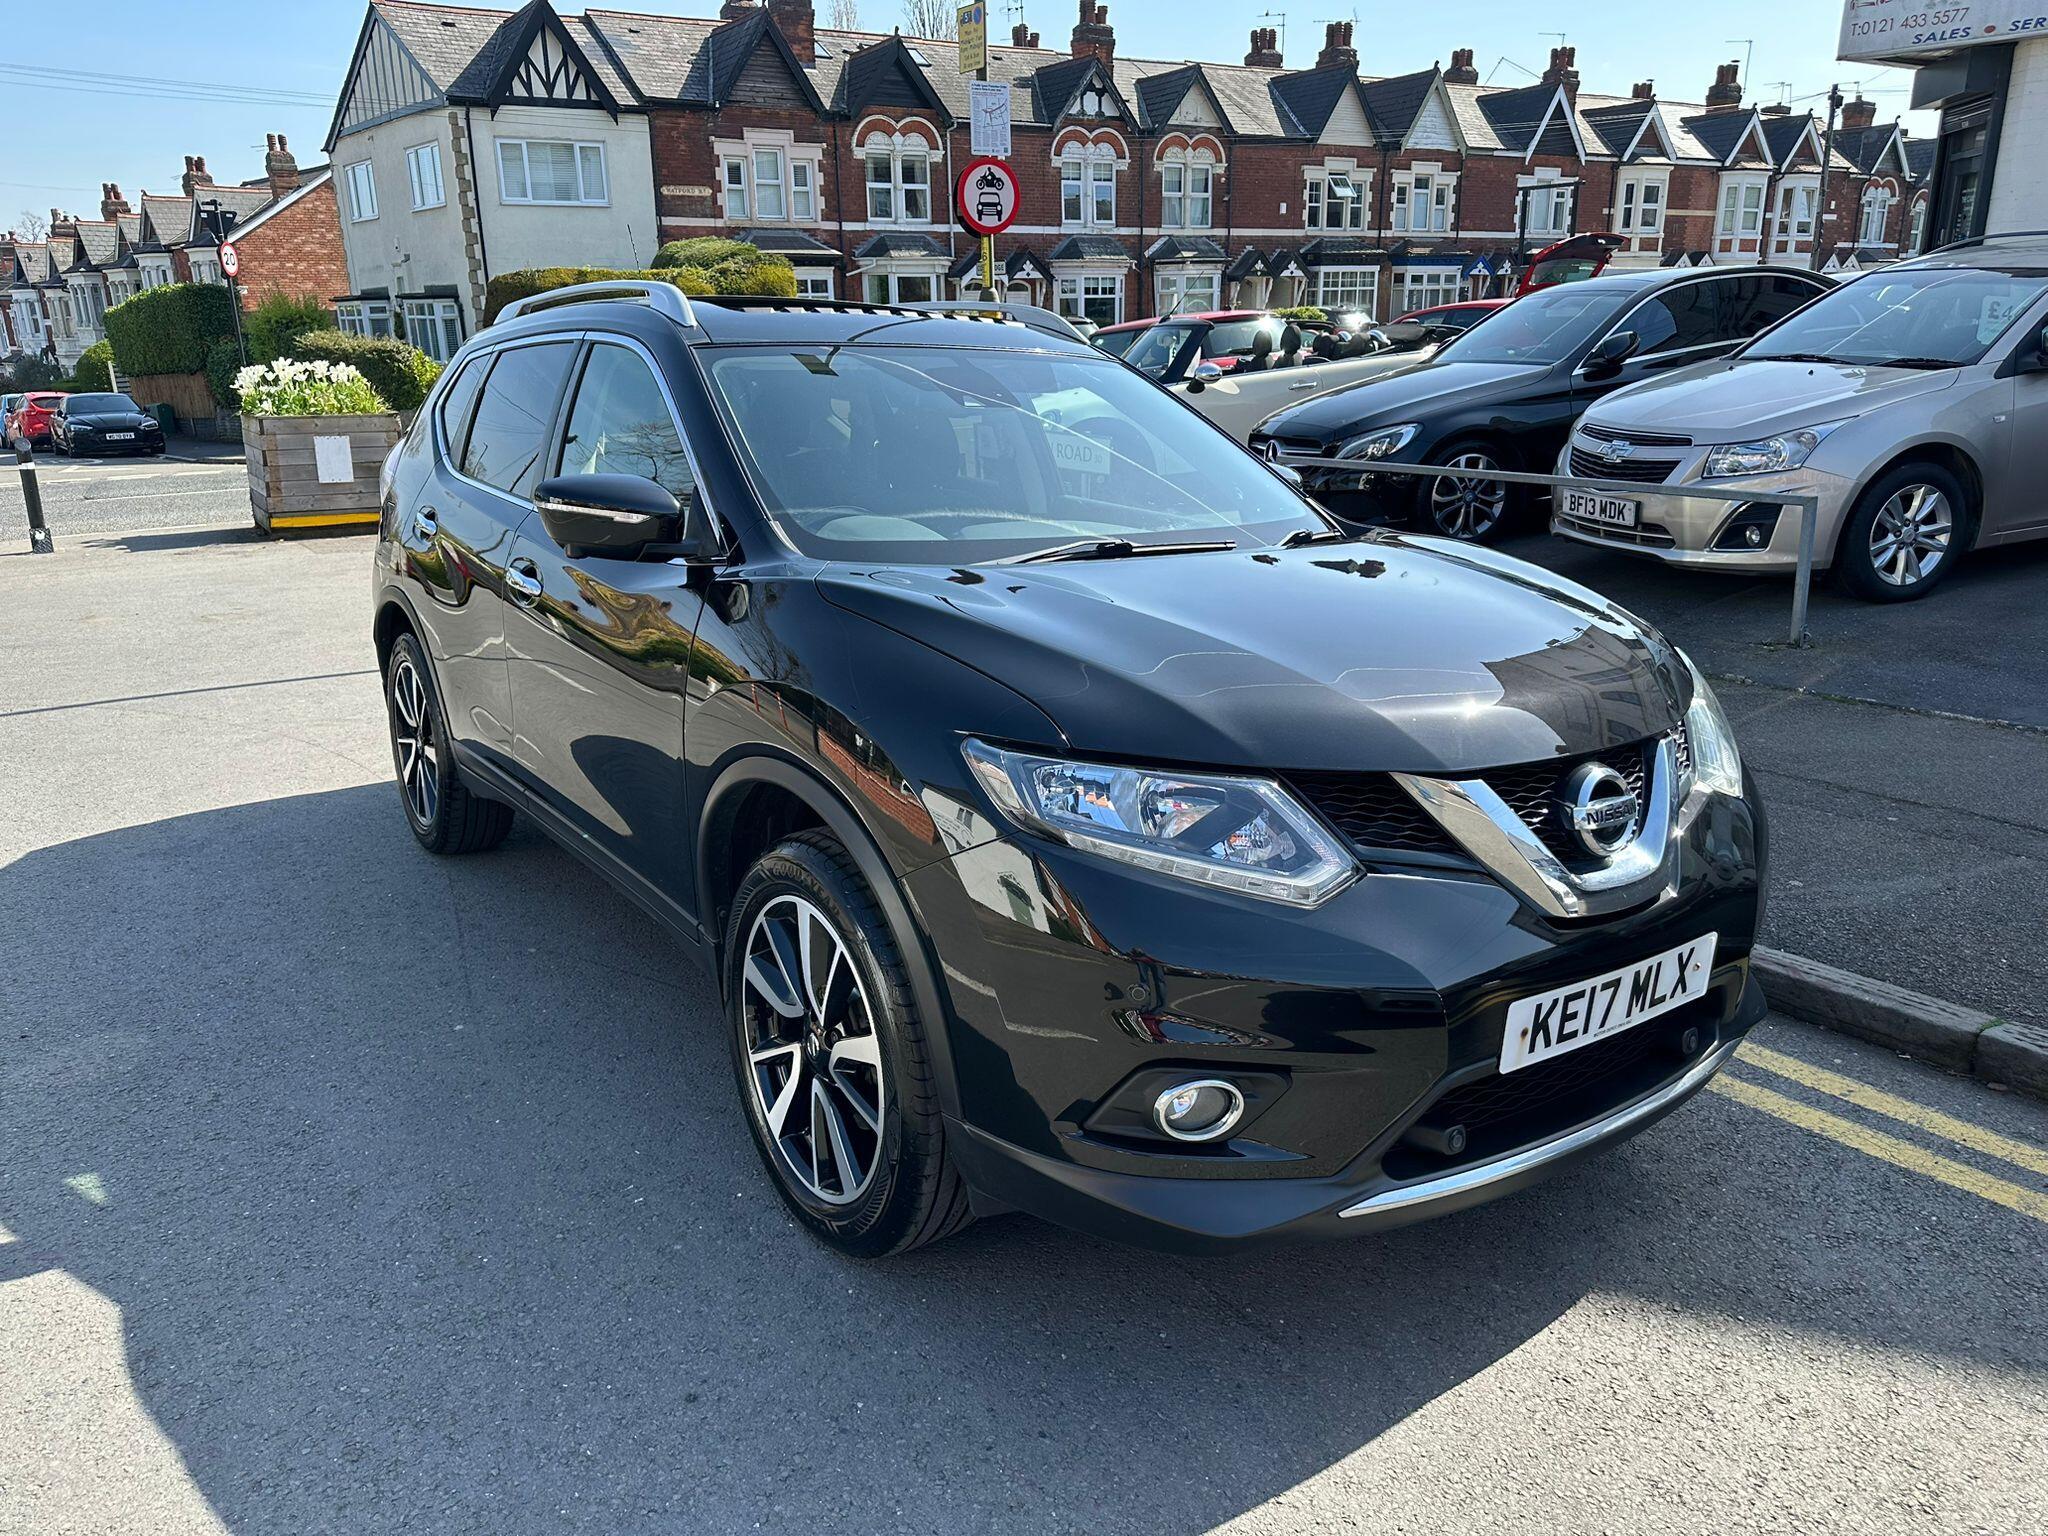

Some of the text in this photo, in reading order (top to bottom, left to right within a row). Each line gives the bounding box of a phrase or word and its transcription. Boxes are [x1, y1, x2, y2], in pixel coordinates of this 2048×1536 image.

[1851, 7, 1969, 36] T:0121 433 5577
[1912, 27, 1971, 44] SALES
[224, 252, 236, 266] 20
[1056, 443, 1093, 463] ROAD
[1569, 494, 1627, 522] BF13 MDK
[1586, 804, 1635, 825] NISSAN
[1528, 946, 1696, 1055] KE17 MLX
